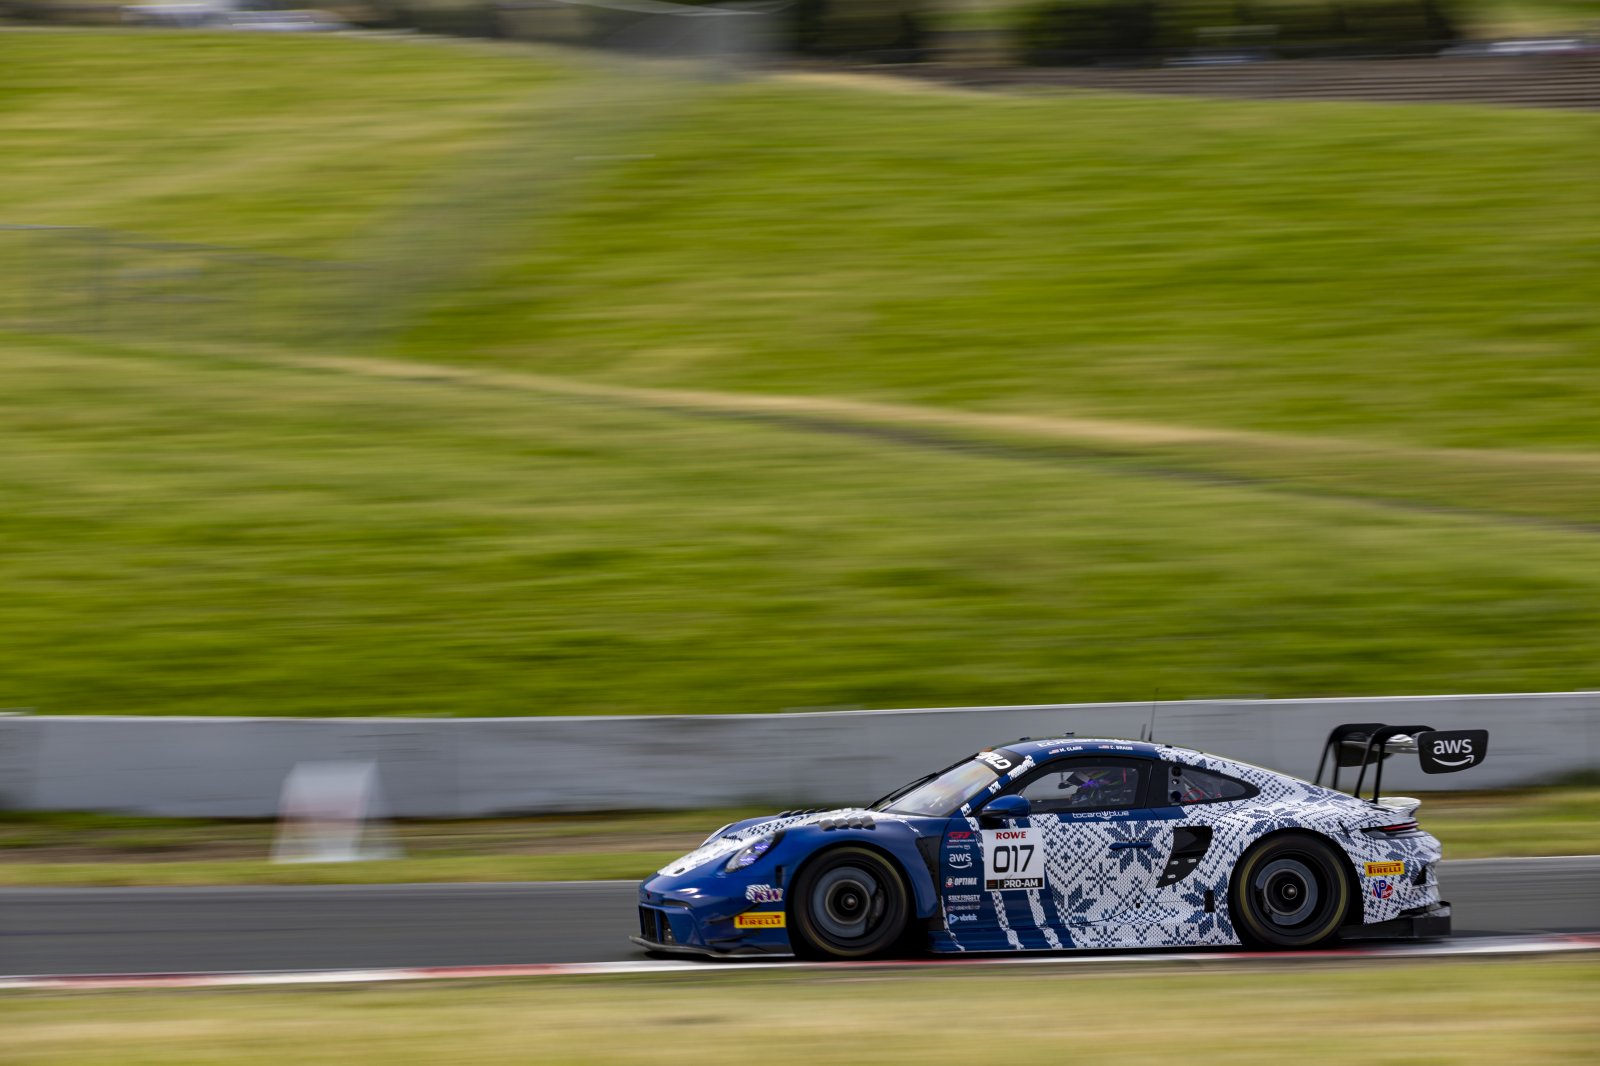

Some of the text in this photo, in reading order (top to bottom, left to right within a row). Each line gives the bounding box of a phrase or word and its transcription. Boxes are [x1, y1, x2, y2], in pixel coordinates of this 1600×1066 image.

[1433, 739, 1473, 755] aws
[996, 831, 1027, 840] ROWE
[949, 853, 972, 863] aws
[994, 845, 1034, 873] 017
[1367, 862, 1402, 875] PIRELLI
[954, 877, 978, 886] OPTIMA
[1003, 879, 1039, 889] PRO-AM
[1373, 879, 1387, 898] VP
[739, 914, 781, 926] PIRELLI
